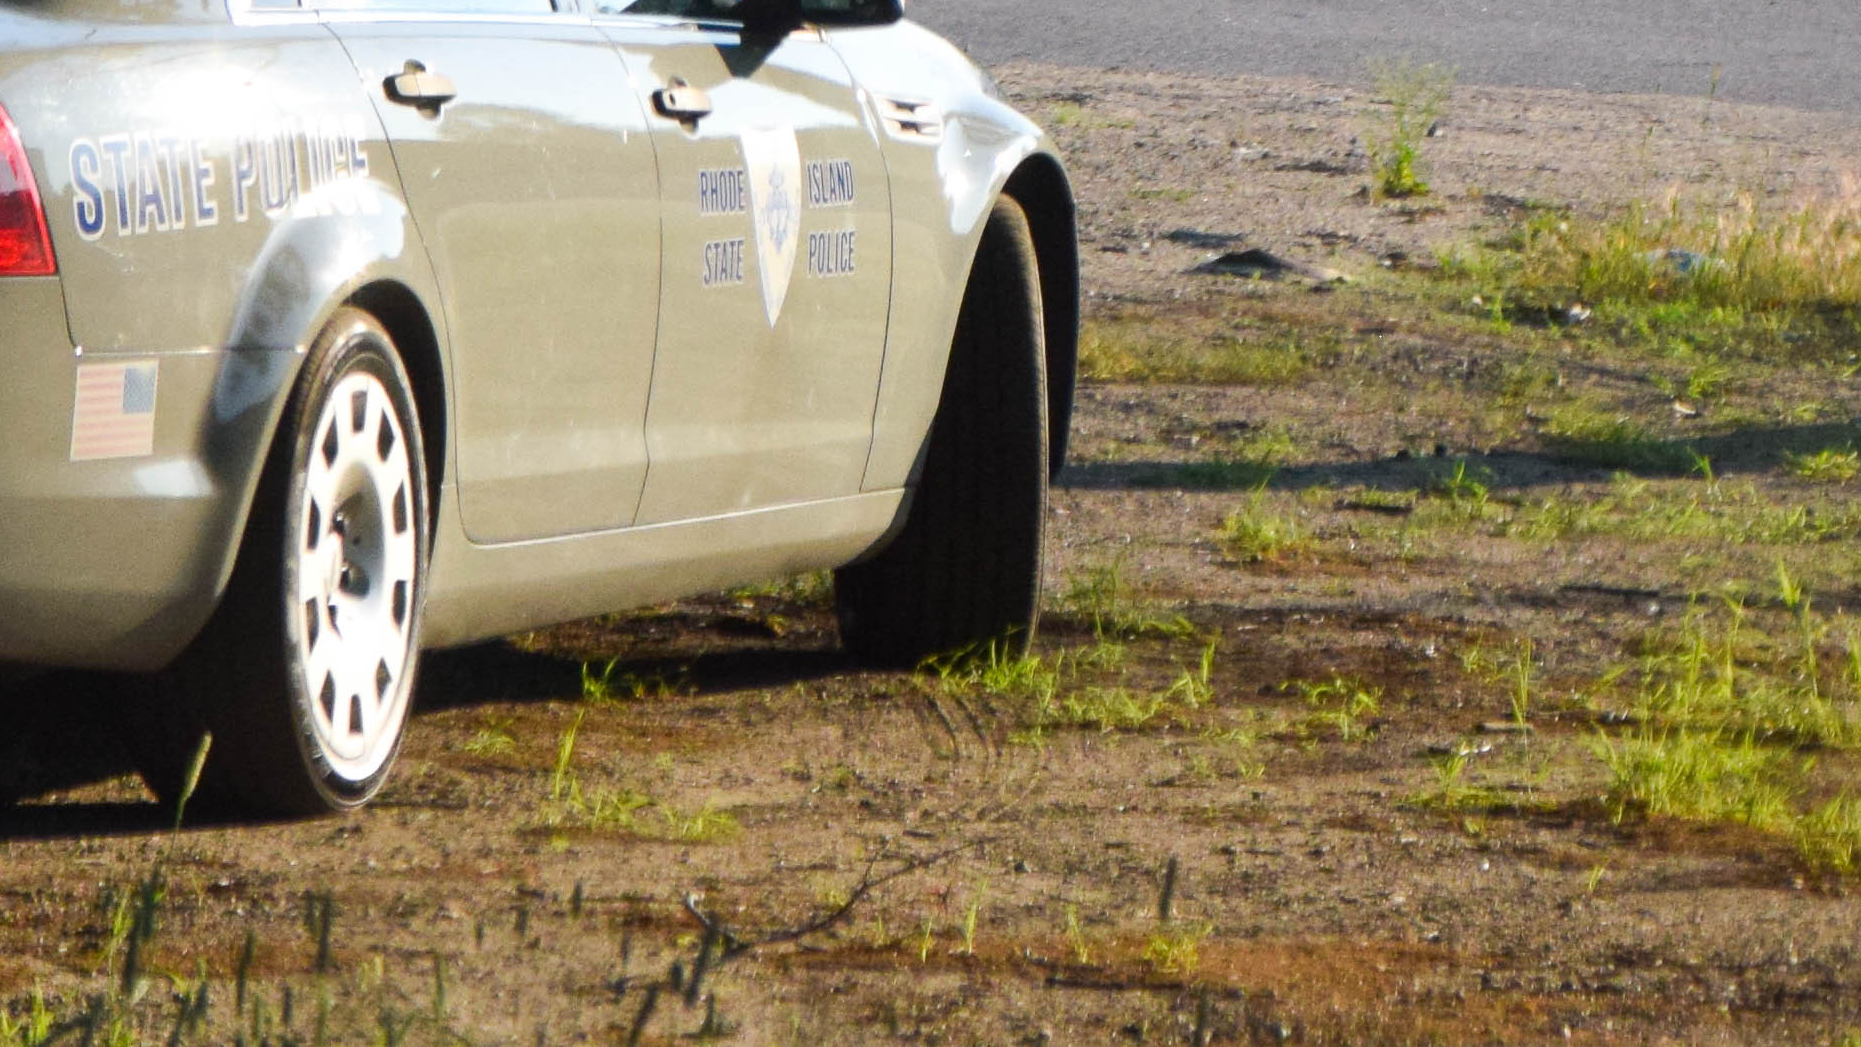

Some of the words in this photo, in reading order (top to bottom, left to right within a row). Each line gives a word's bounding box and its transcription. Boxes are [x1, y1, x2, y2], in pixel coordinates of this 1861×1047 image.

[70, 129, 219, 242] STATE
[698, 168, 746, 215] RHODE
[806, 158, 856, 207] ISLAND
[703, 239, 745, 286] STATE
[807, 229, 856, 276] POLICE
